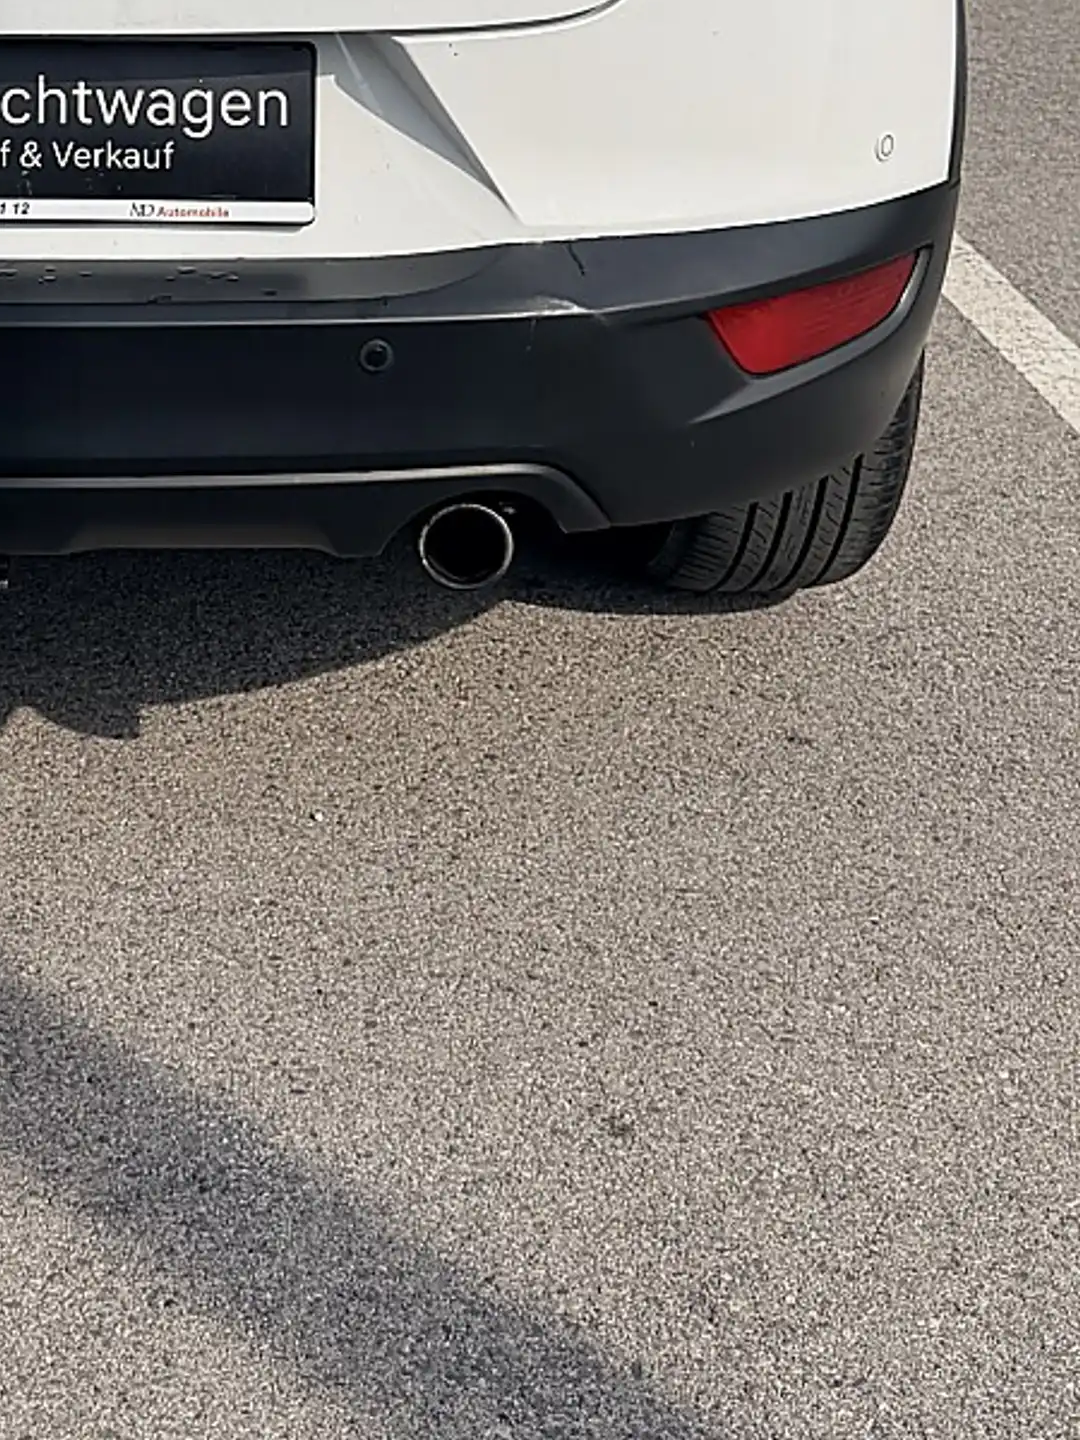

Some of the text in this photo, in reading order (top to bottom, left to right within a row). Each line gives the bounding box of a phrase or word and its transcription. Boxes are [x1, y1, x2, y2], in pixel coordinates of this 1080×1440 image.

[19, 141, 43, 168] &
[51, 141, 175, 170] Verkauf
[13, 201, 31, 215] 12
[156, 206, 230, 218] Automobile
